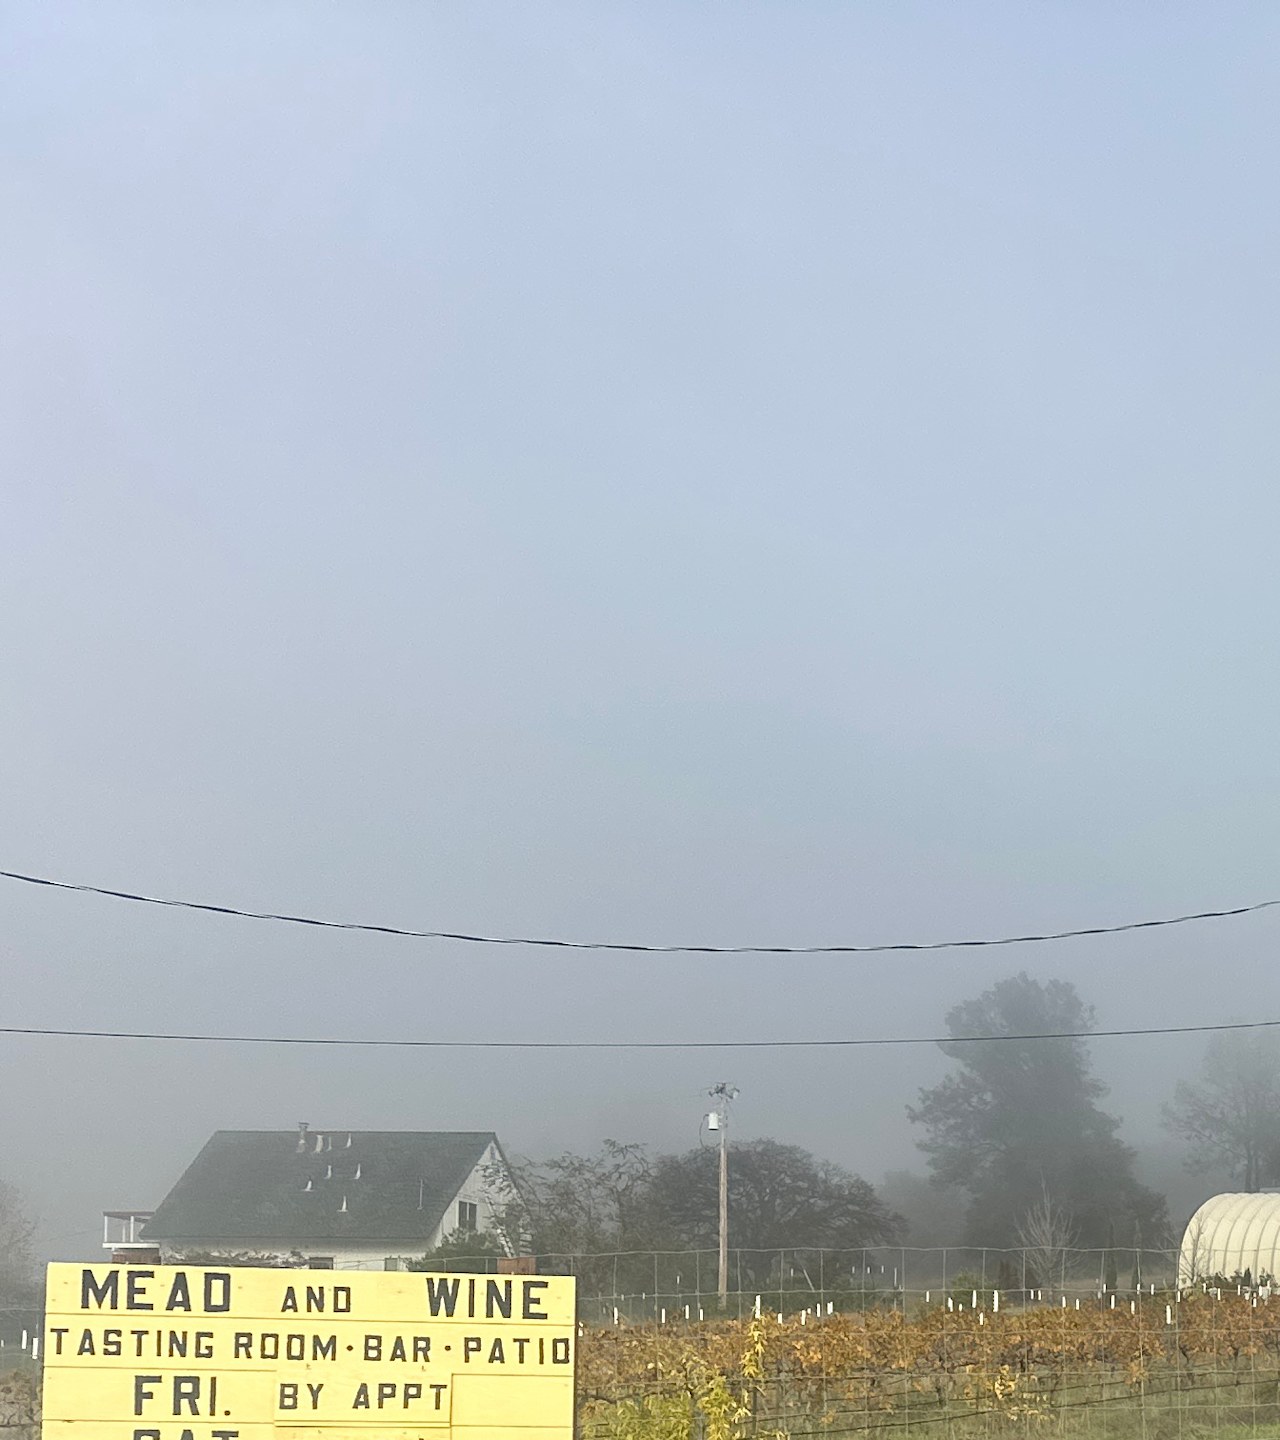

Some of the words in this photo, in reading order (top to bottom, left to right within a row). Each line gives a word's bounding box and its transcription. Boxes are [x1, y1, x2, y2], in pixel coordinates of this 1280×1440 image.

[80, 1268, 232, 1313] MEAD
[280, 1286, 351, 1313] AND
[425, 1277, 549, 1320] WINE
[50, 1328, 214, 1359] TASTING
[234, 1332, 337, 1361] ROOM
[363, 1334, 431, 1363] BAR
[464, 1336, 570, 1365] PATIO
[134, 1375, 231, 1417] FRI.
[279, 1383, 324, 1410] BY
[352, 1382, 448, 1410] APPT
